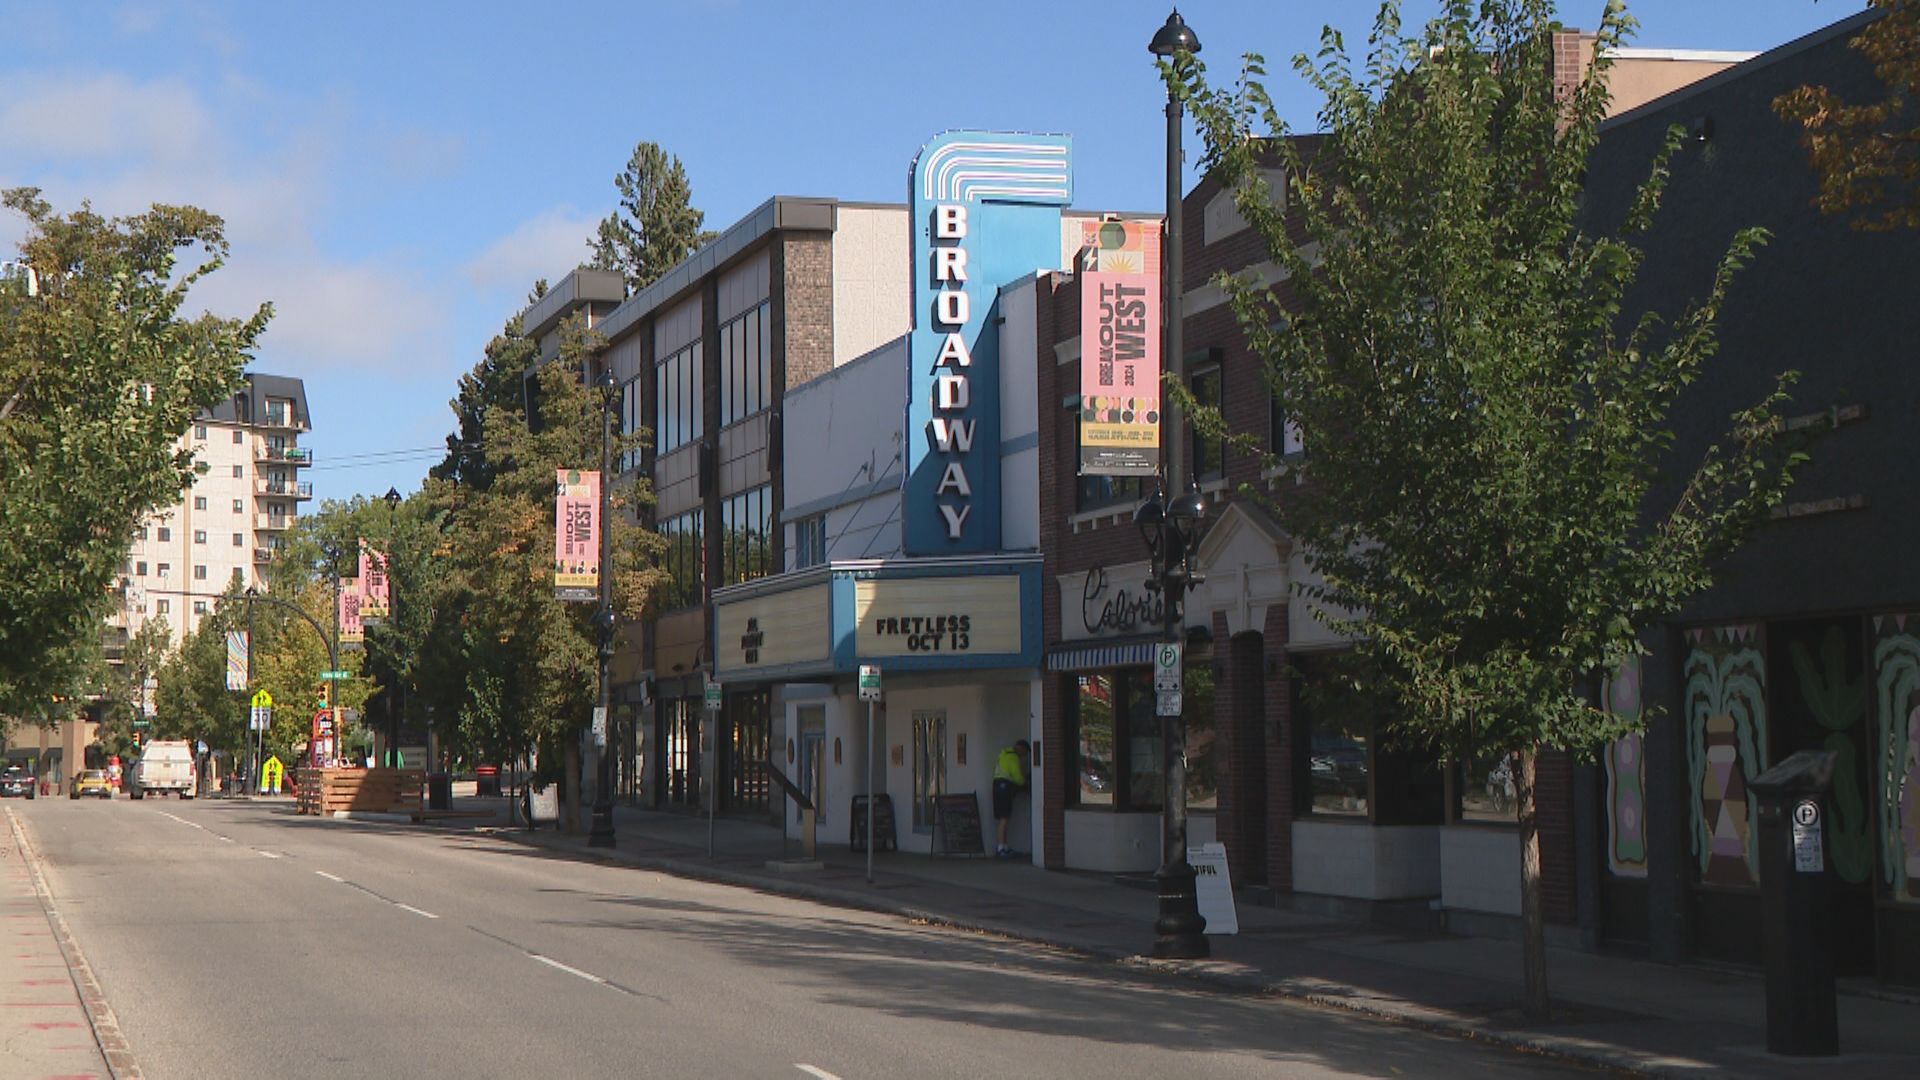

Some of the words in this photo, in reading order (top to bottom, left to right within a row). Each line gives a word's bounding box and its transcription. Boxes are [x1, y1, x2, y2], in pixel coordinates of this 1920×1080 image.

[1099, 281, 1113, 386] BREAKOUT
[1115, 283, 1146, 361] WEST
[932, 203, 976, 539] BROADWAY
[574, 501, 591, 542] WEST
[876, 614, 971, 636] FRETLESS
[1082, 566, 1166, 633] Calorie
[907, 632, 944, 652] OCT
[951, 633, 970, 651] 13
[1194, 864, 1217, 875] TIFUL
